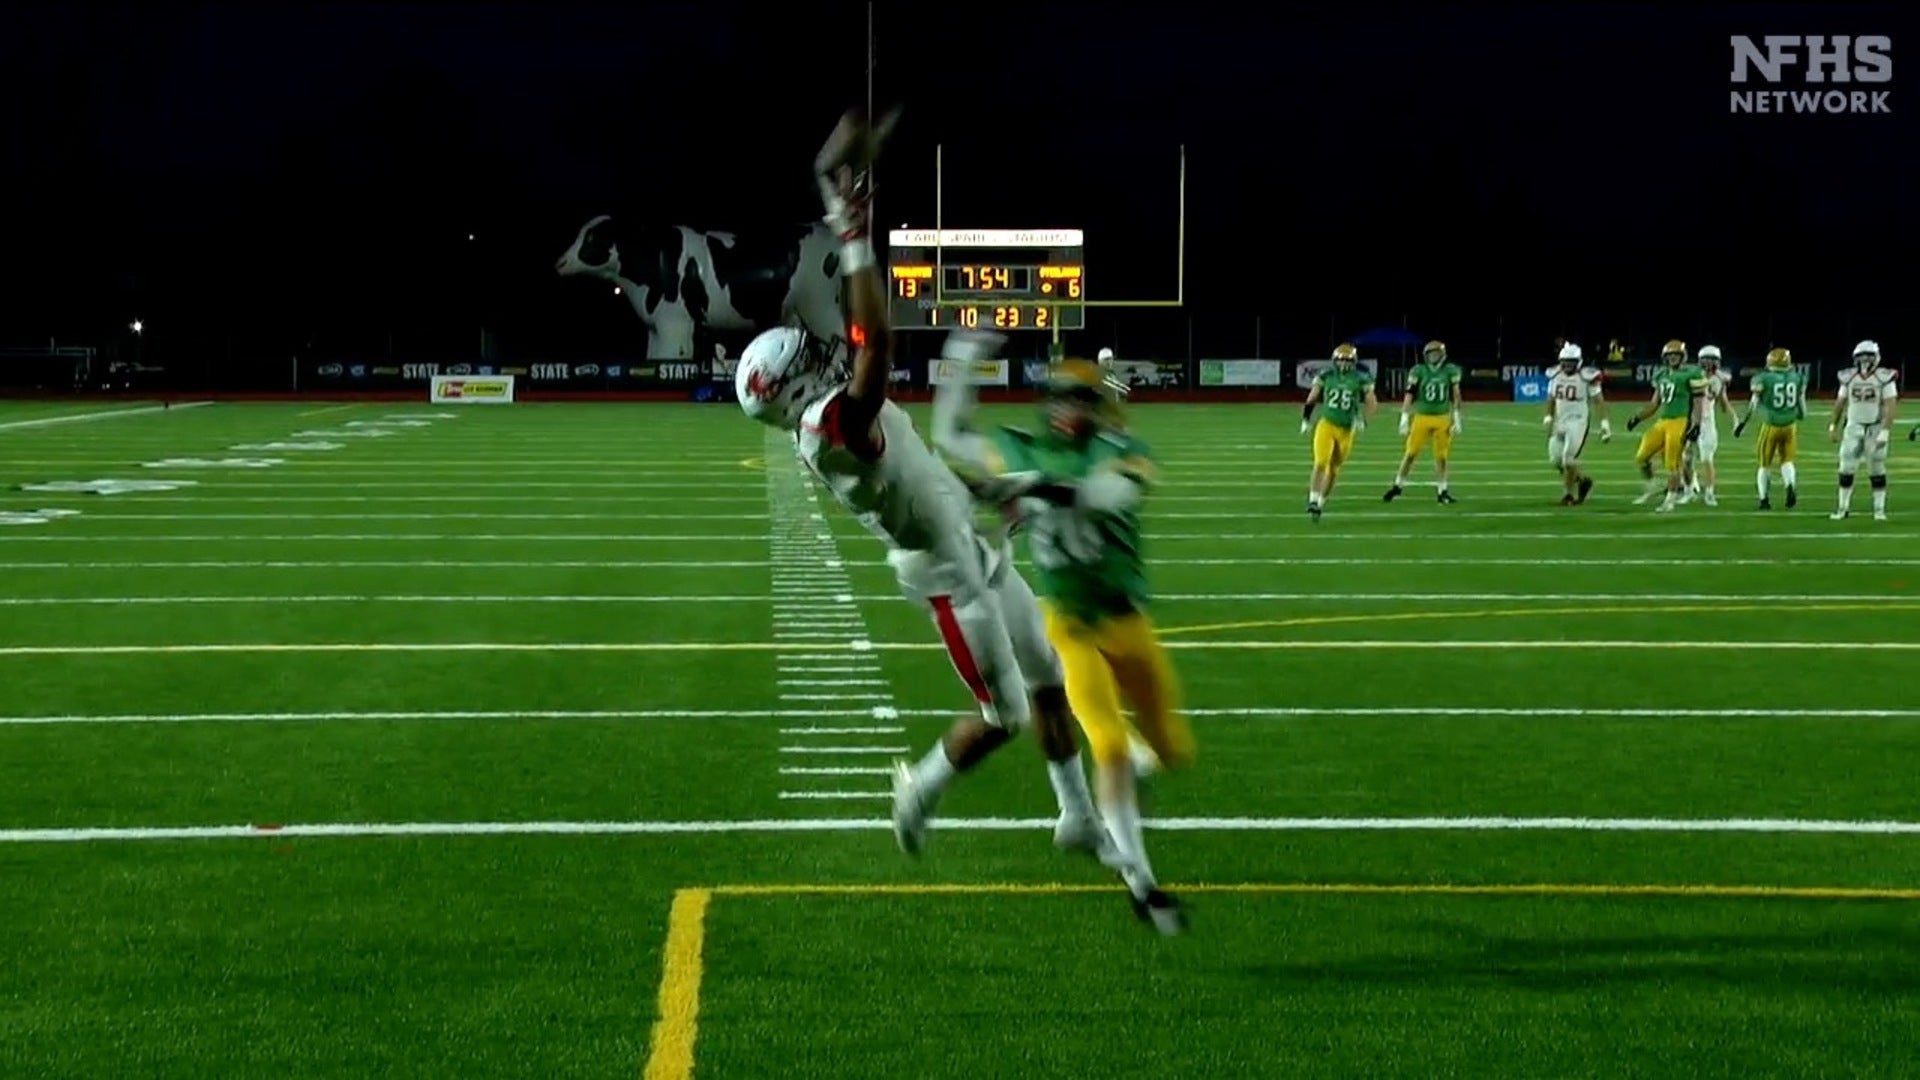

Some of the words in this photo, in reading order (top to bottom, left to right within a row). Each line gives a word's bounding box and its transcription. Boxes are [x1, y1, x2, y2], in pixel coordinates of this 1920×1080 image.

[899, 279, 917, 298] 13
[1068, 279, 1081, 298] 6
[960, 307, 978, 327] 10
[995, 307, 1020, 327] 23
[1035, 307, 1049, 327] 2
[402, 363, 439, 379] STATE
[530, 363, 569, 379] STATE
[1773, 382, 1797, 407] 59
[1851, 387, 1876, 404] 52
